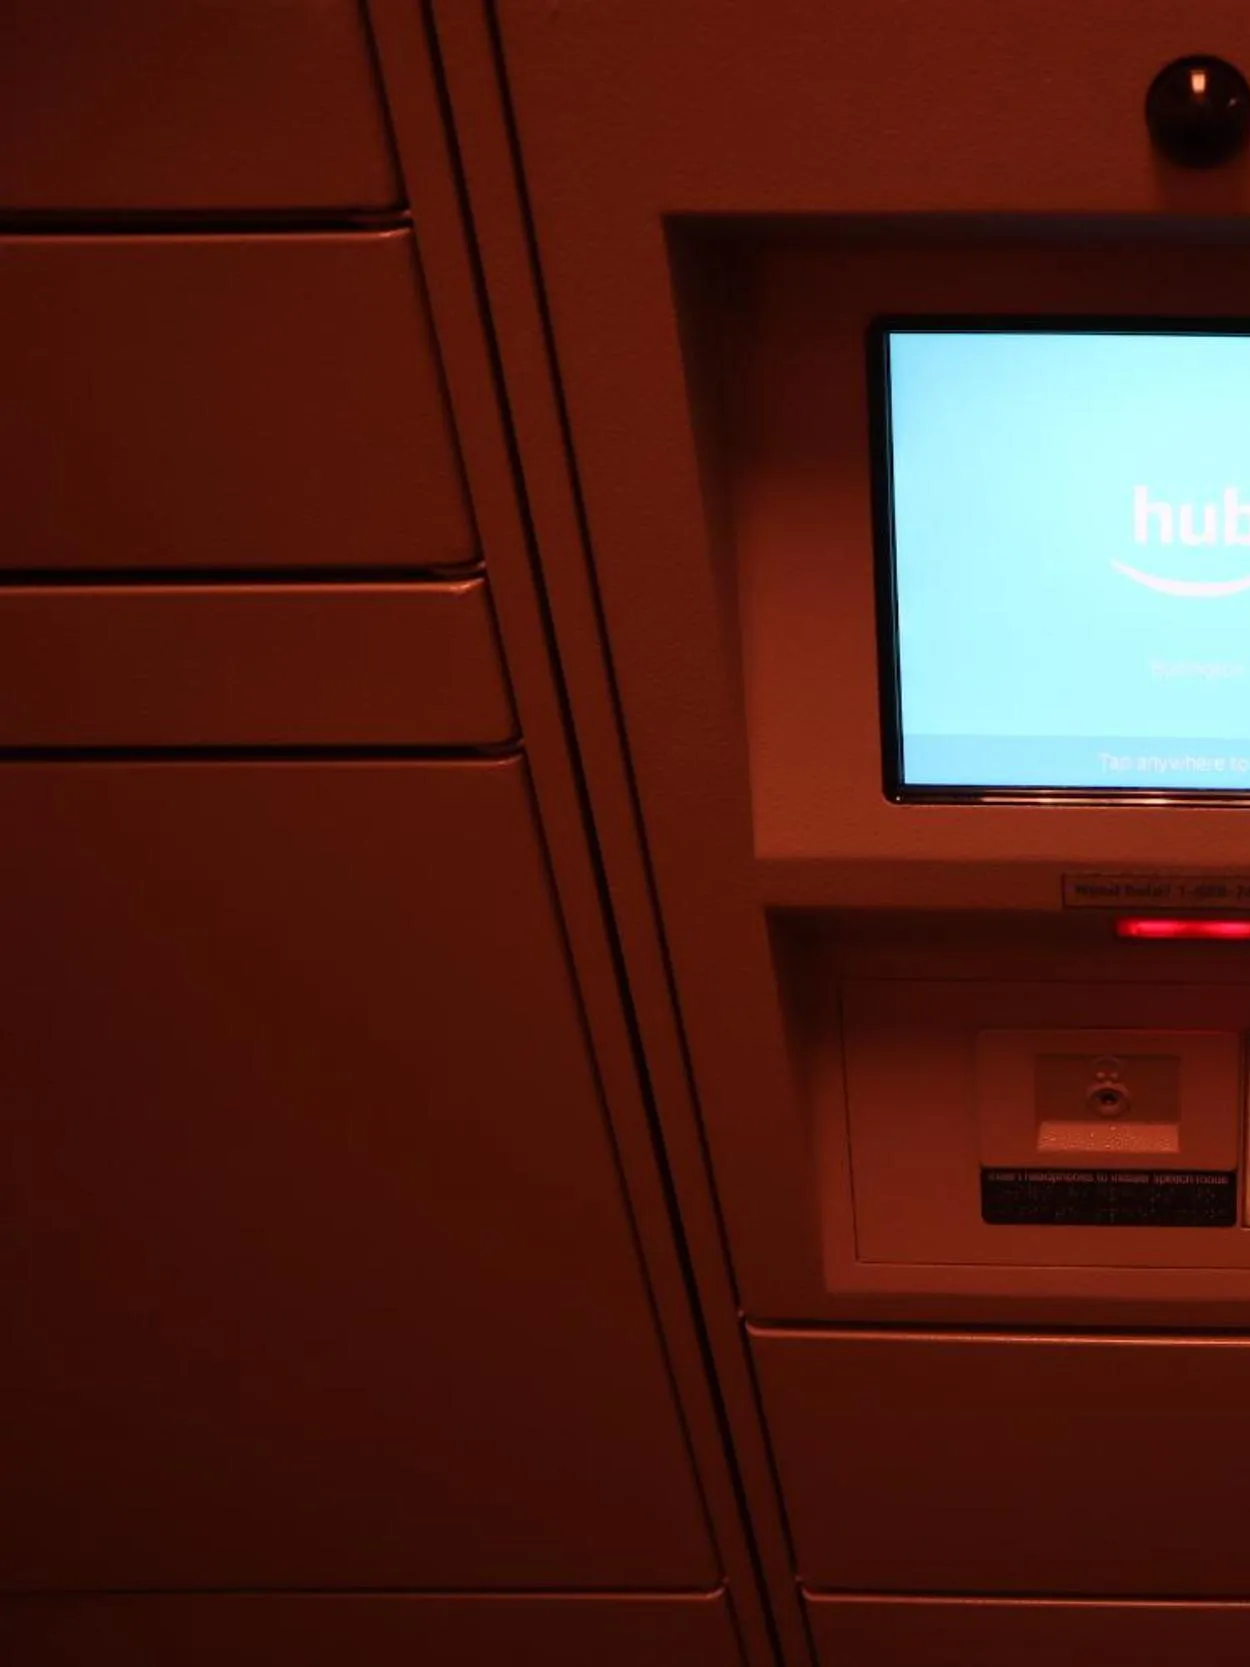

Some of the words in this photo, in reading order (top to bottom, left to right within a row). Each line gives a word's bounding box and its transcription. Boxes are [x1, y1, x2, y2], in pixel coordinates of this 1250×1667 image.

[1100, 752, 1131, 775] Tap
[1137, 754, 1226, 774] anywhere
[1230, 756, 1250, 773] to
